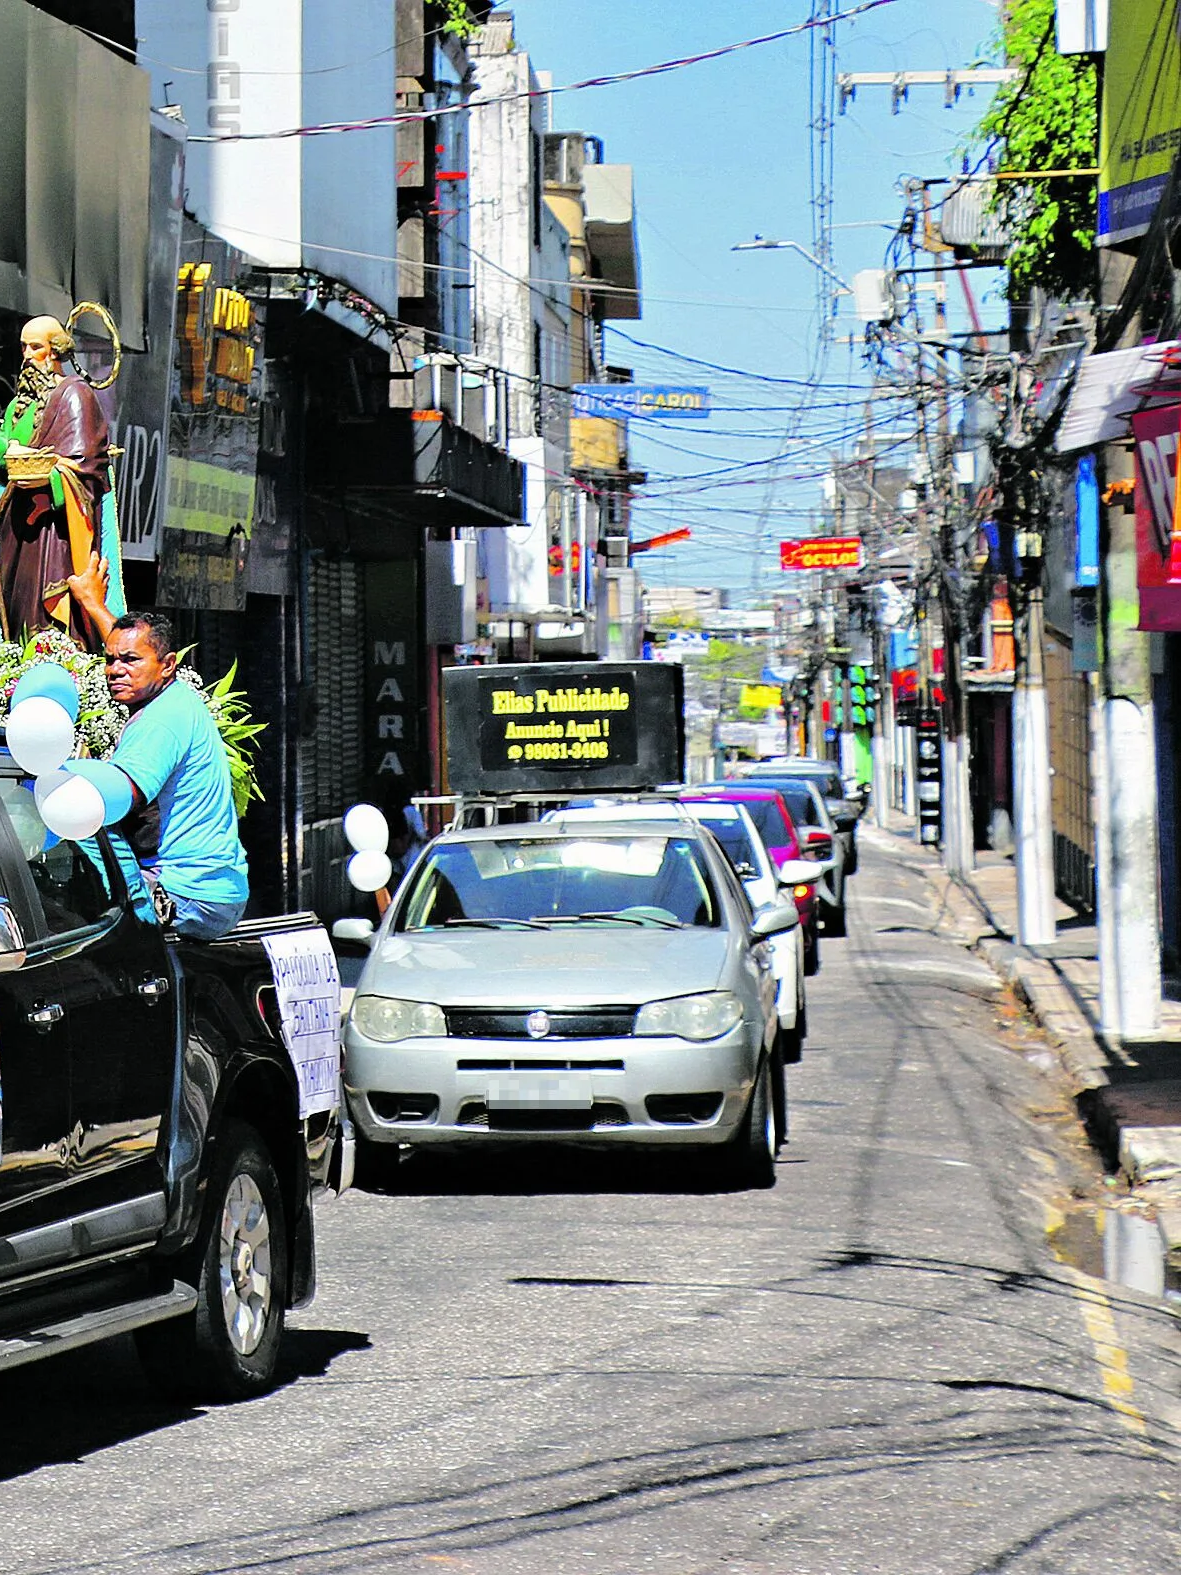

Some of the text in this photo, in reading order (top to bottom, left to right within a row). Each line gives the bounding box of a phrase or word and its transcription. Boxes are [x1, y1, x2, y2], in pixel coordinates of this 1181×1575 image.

[374, 641, 405, 775] MARA
[492, 687, 630, 714] Elias Publicidade
[505, 720, 564, 739] Anuncie
